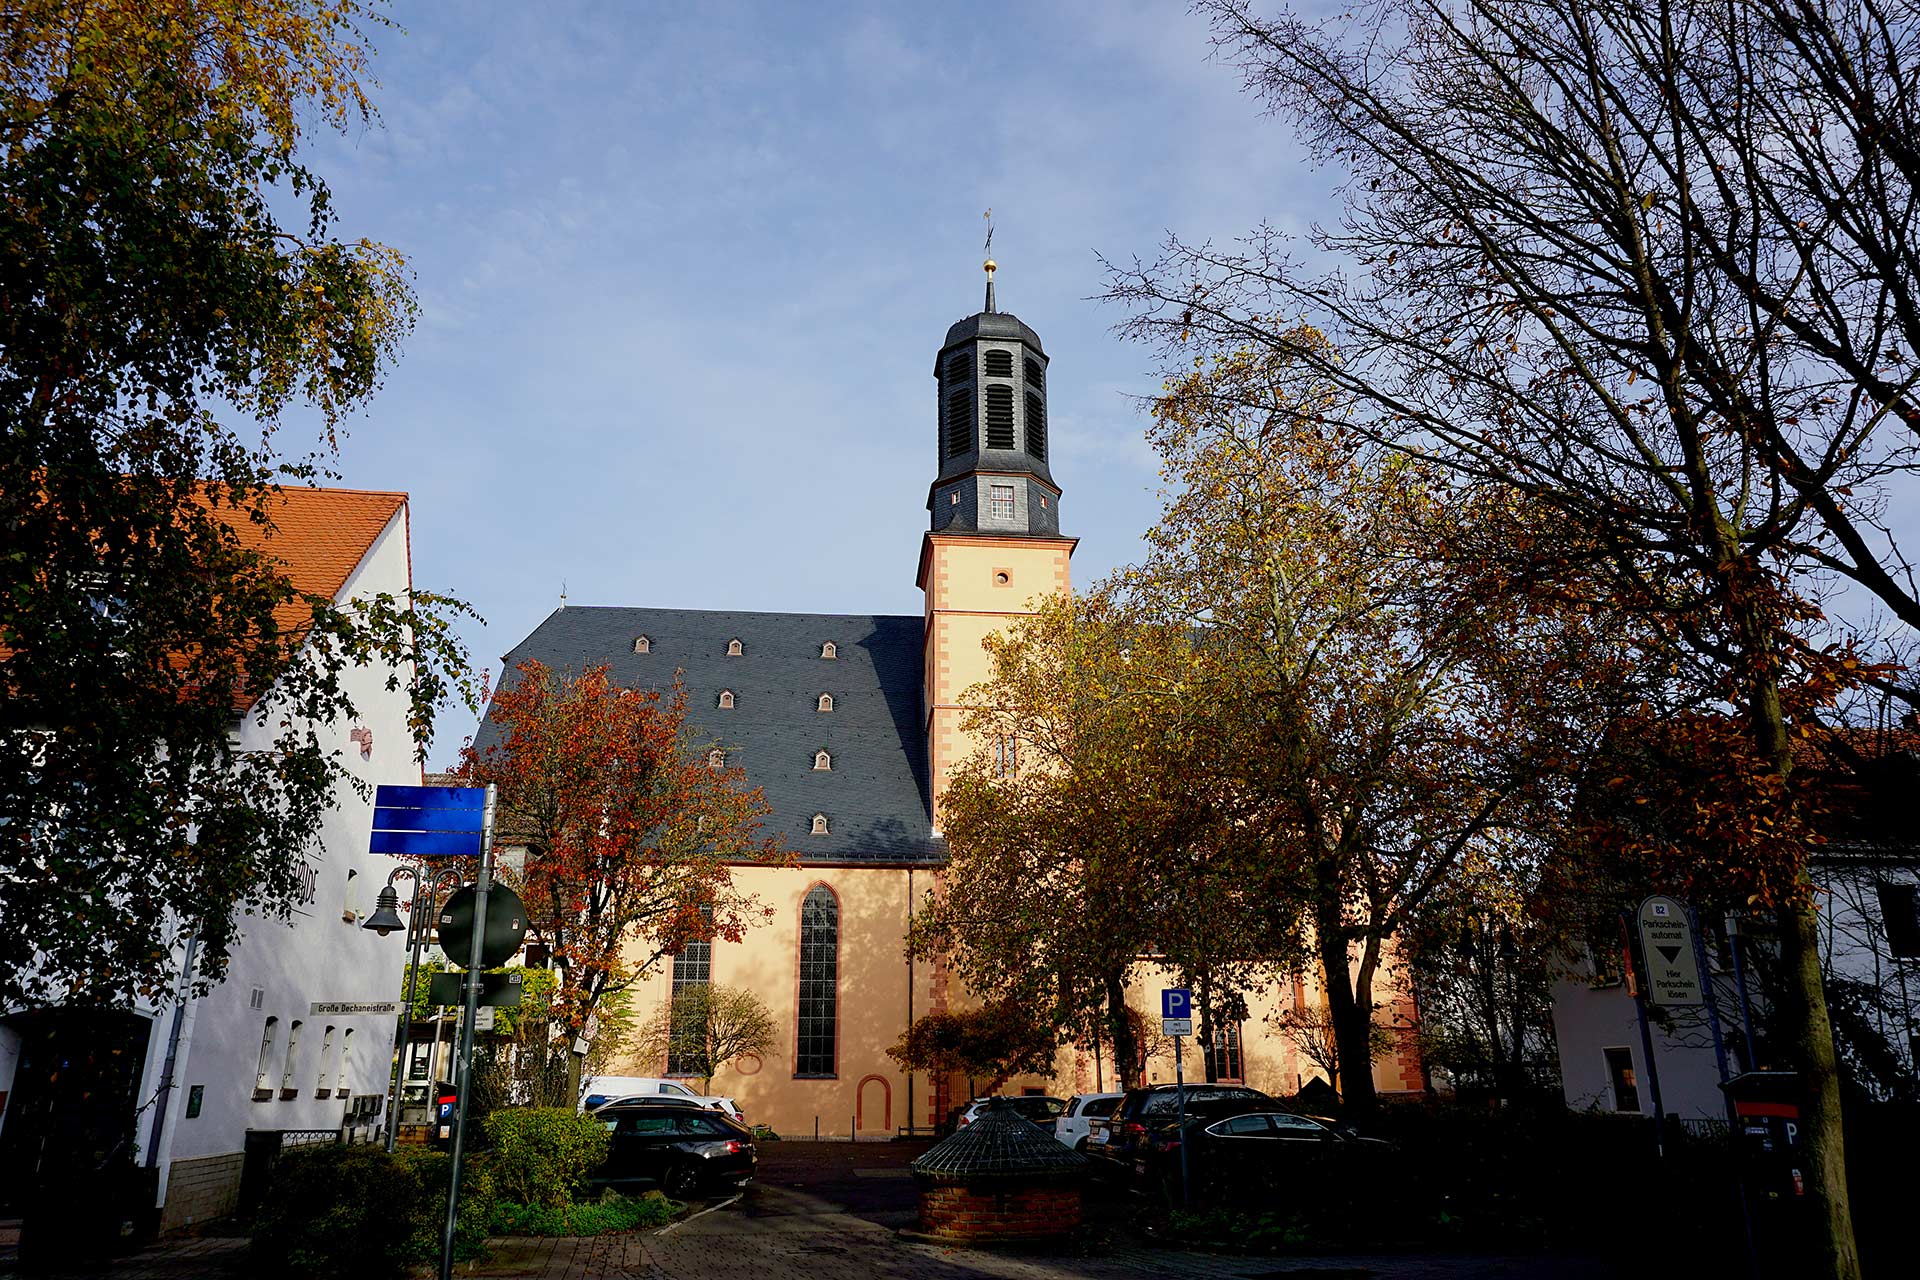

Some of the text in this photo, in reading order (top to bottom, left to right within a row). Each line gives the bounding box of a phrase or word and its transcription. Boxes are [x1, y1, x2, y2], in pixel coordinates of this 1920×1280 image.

[1655, 905, 1665, 914] 82
[1643, 919, 1688, 929] Parkschein-
[1651, 930, 1682, 940] automat
[1666, 969, 1681, 978] Hier
[1656, 979, 1695, 988] Parkschein
[1667, 989, 1688, 999] lösen
[318, 1003, 395, 1012] Große Dechaneistraße
[1169, 992, 1184, 1015] P
[441, 1104, 450, 1116] P
[1786, 1122, 1798, 1145] P
